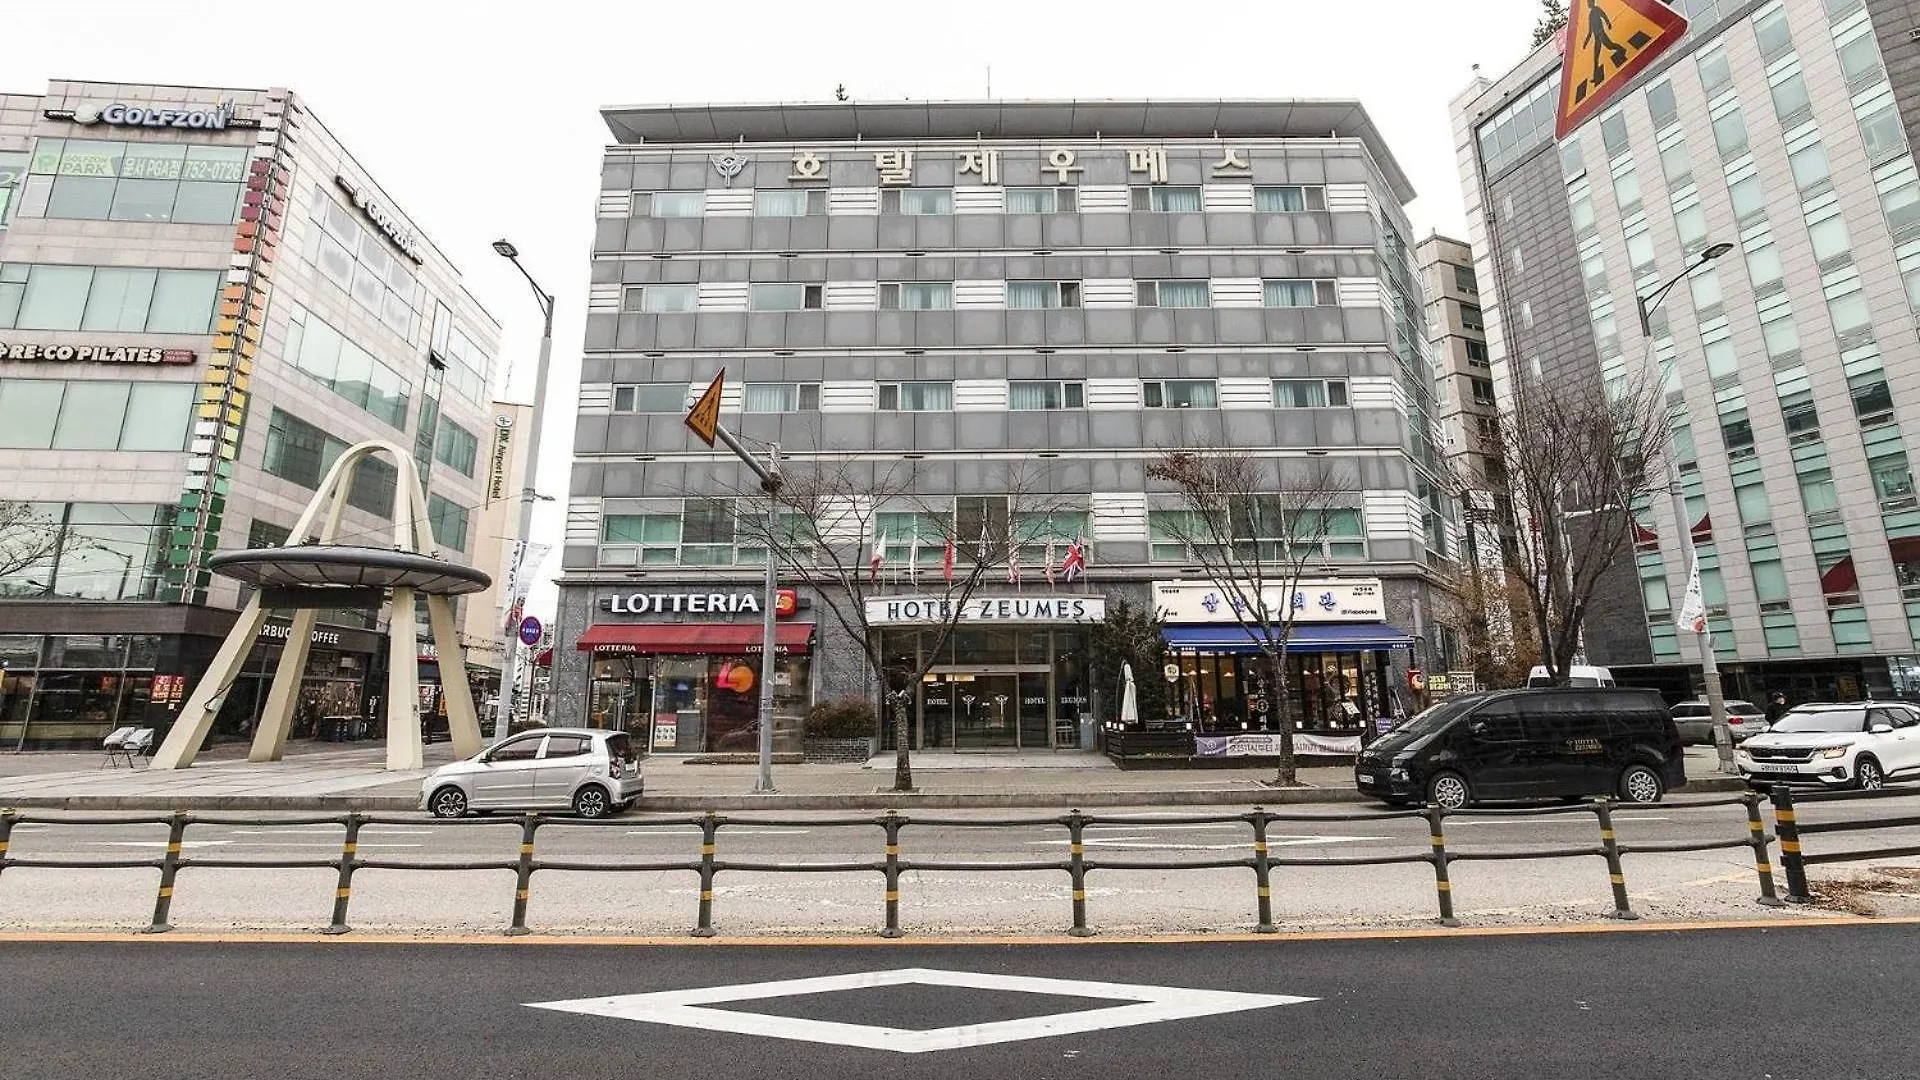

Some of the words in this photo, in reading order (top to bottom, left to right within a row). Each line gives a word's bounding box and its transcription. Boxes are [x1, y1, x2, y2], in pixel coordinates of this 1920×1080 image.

[102, 103, 225, 129] GOLFZON
[63, 162, 106, 175] PARK
[365, 198, 417, 258] GOLFZON
[77, 346, 164, 363] PILATES
[611, 593, 760, 614] LOTTERIA
[887, 601, 968, 619] HOTEL
[980, 600, 1087, 619] ZEUMES
[311, 630, 340, 644] OFFEE
[594, 644, 637, 652] LOTTERIA
